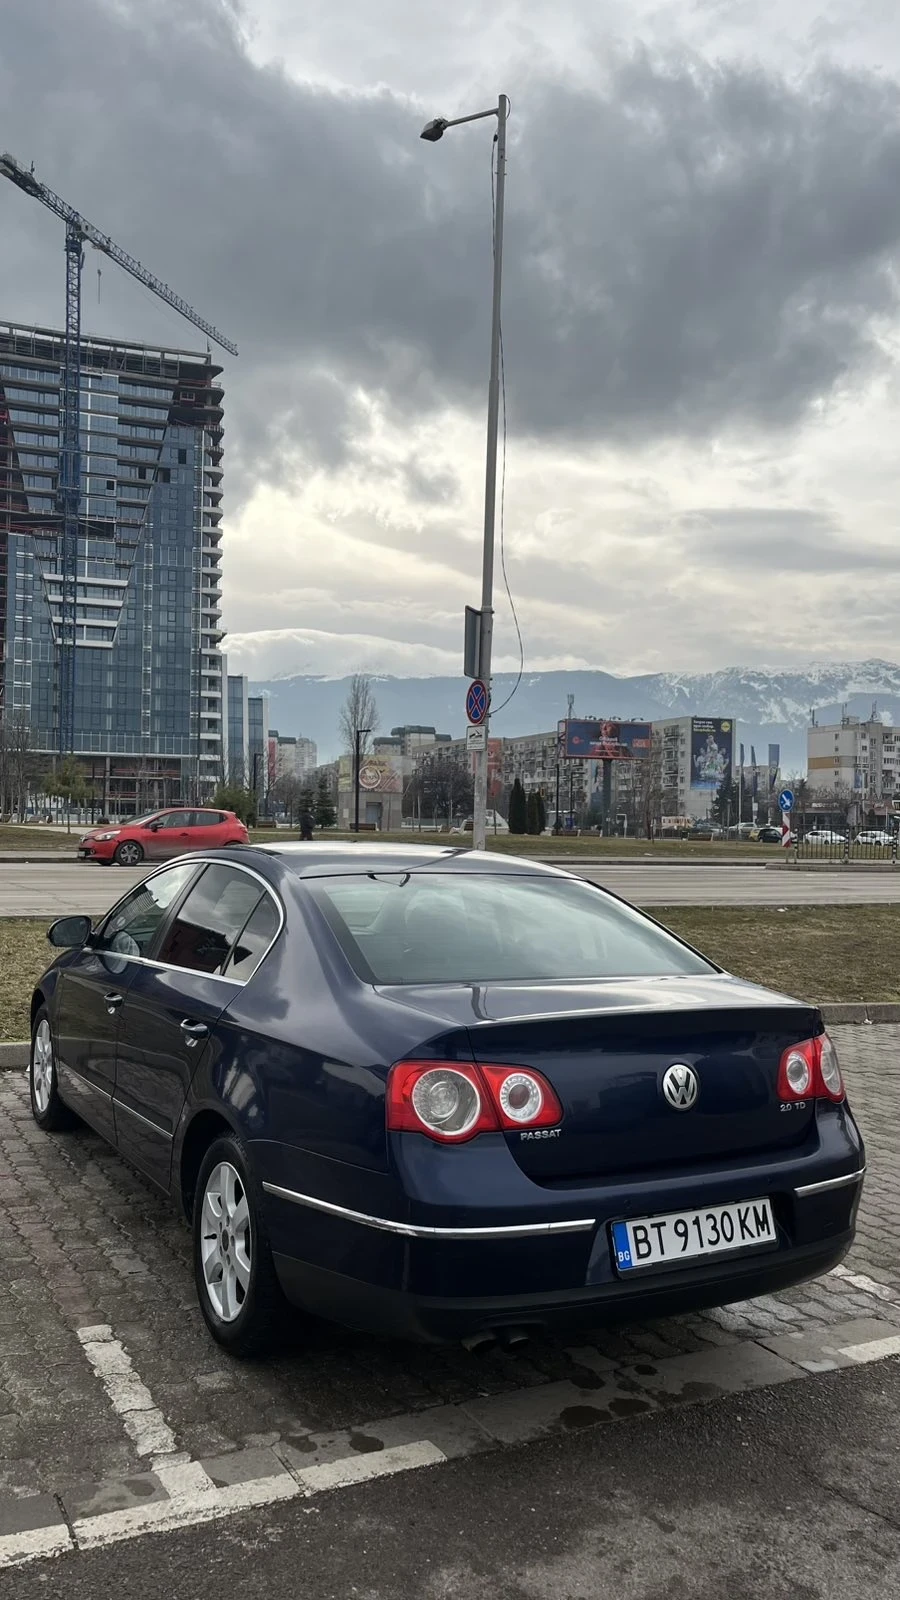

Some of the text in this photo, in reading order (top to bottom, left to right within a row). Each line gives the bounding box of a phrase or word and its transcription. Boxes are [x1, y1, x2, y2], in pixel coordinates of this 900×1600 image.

[795, 1101, 806, 1110] TD
[520, 1128, 562, 1141] PASSAT
[617, 1250, 630, 1262] BG
